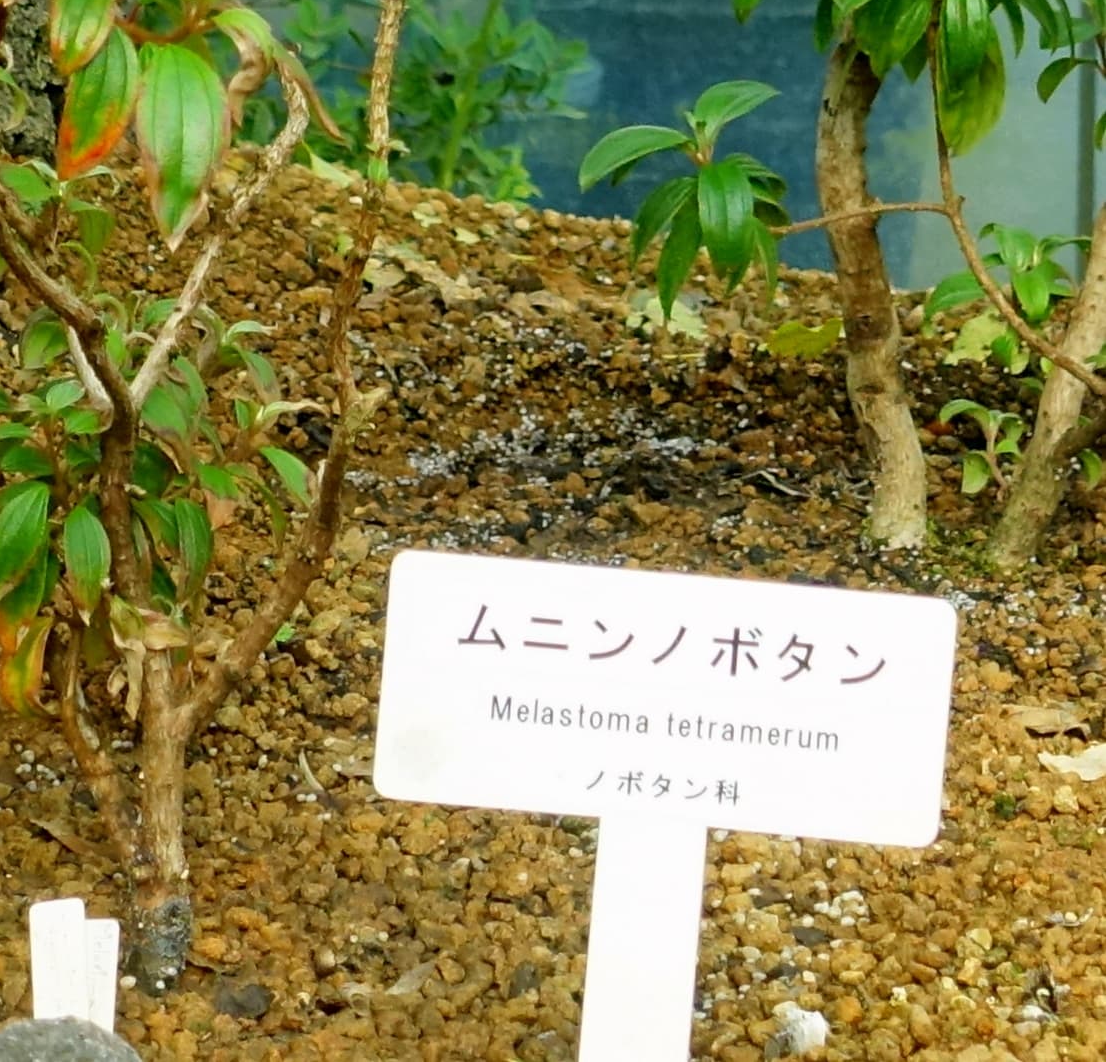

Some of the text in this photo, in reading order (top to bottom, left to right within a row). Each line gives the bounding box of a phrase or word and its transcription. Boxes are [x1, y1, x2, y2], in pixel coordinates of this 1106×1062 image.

[458, 605, 886, 684] ムニンノボタン
[491, 696, 838, 749] Melastoma tetramerum
[587, 772, 738, 805] ノボタン科
